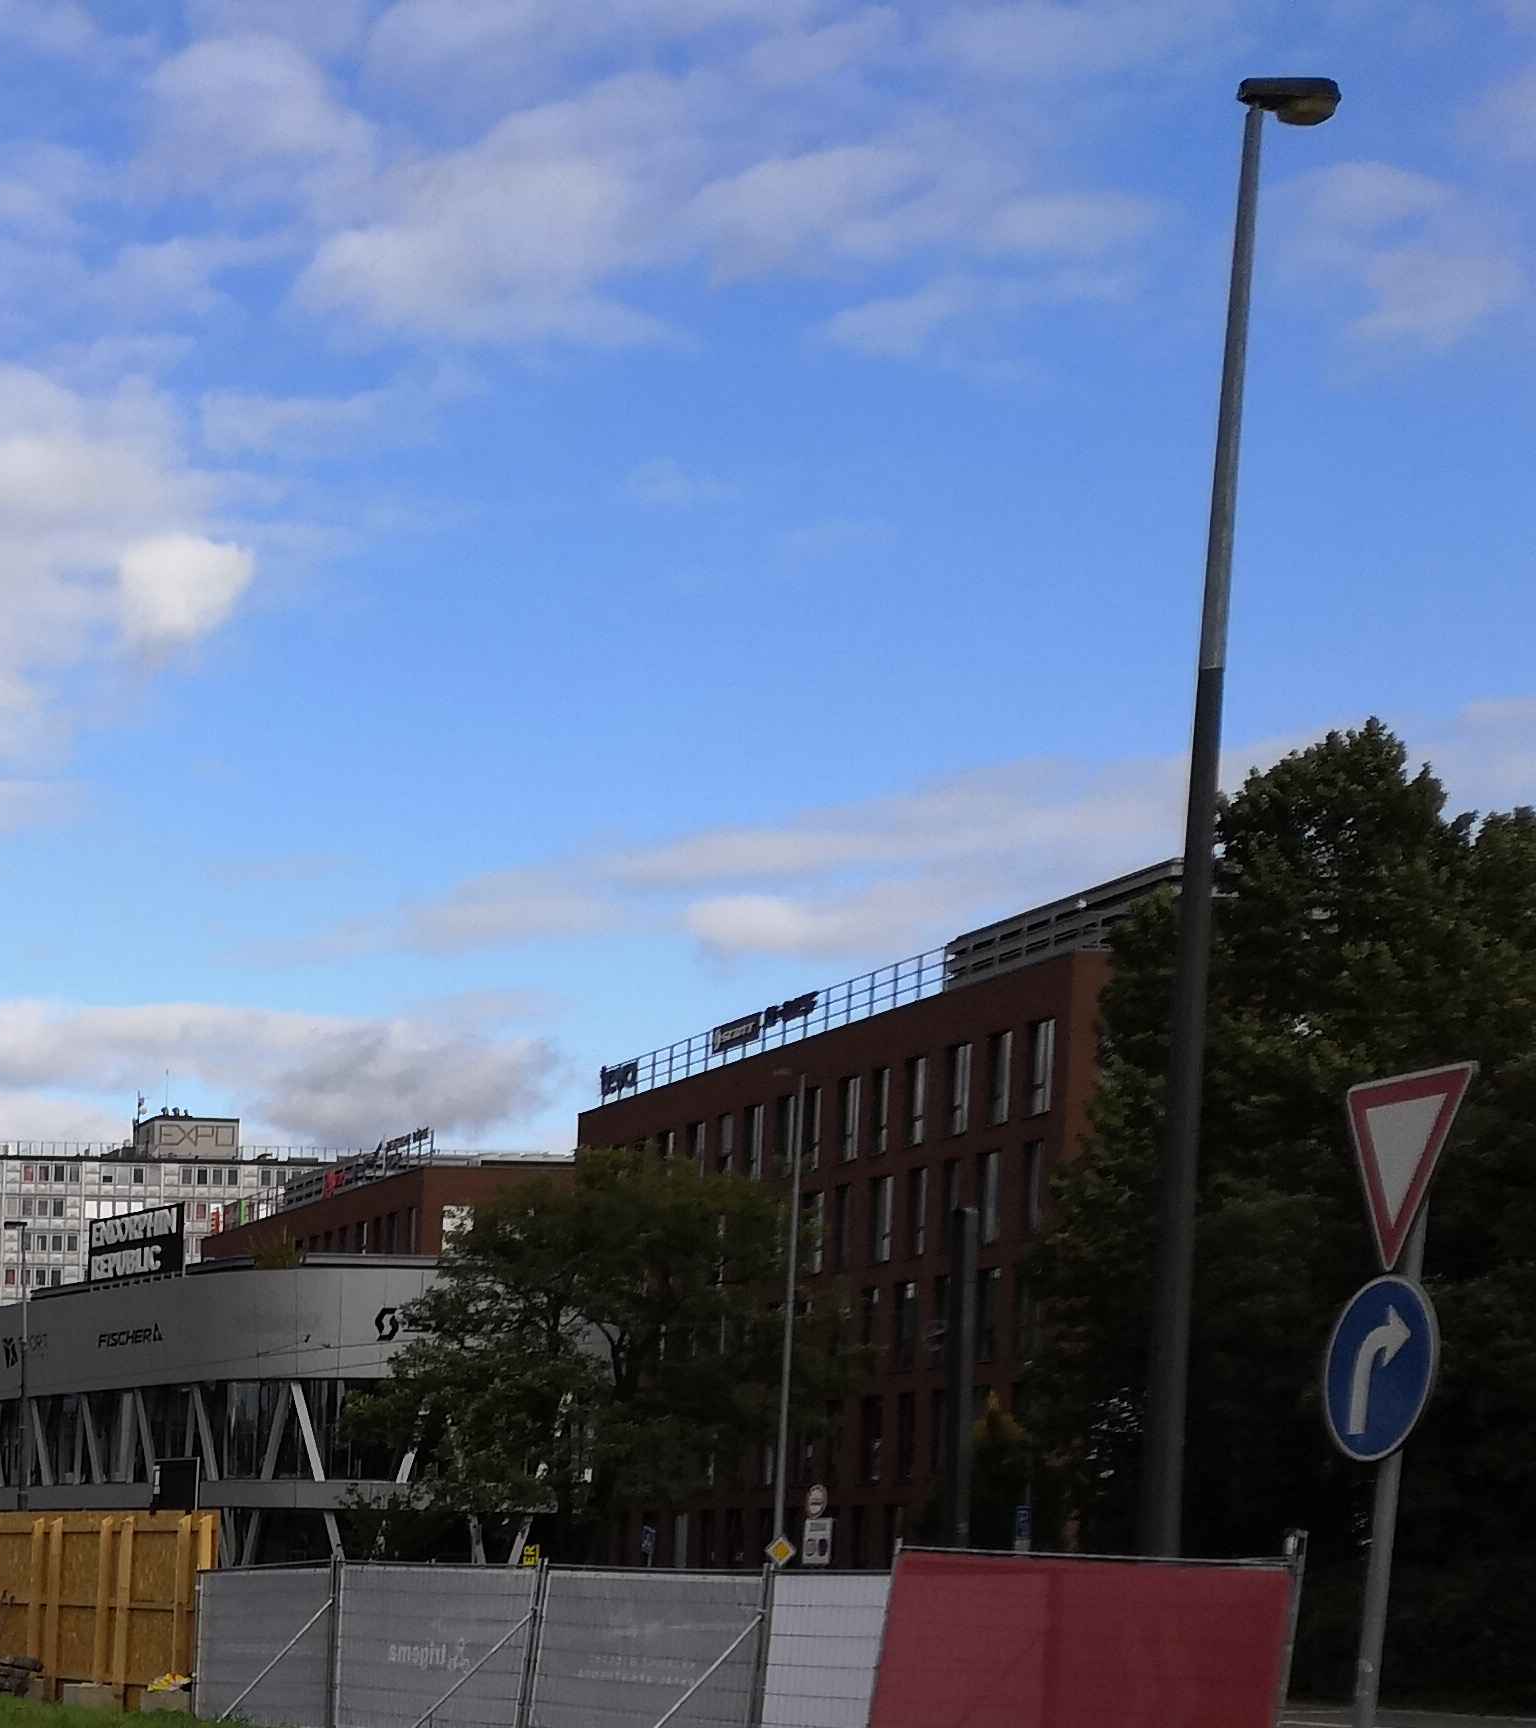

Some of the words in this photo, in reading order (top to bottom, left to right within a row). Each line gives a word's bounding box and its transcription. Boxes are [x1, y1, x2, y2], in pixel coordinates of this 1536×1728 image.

[159, 1125, 235, 1147] EXPO
[92, 1207, 177, 1248] ENDORPHIN
[91, 1245, 162, 1281] REPUBLIC
[98, 1328, 153, 1349] FISCHER
